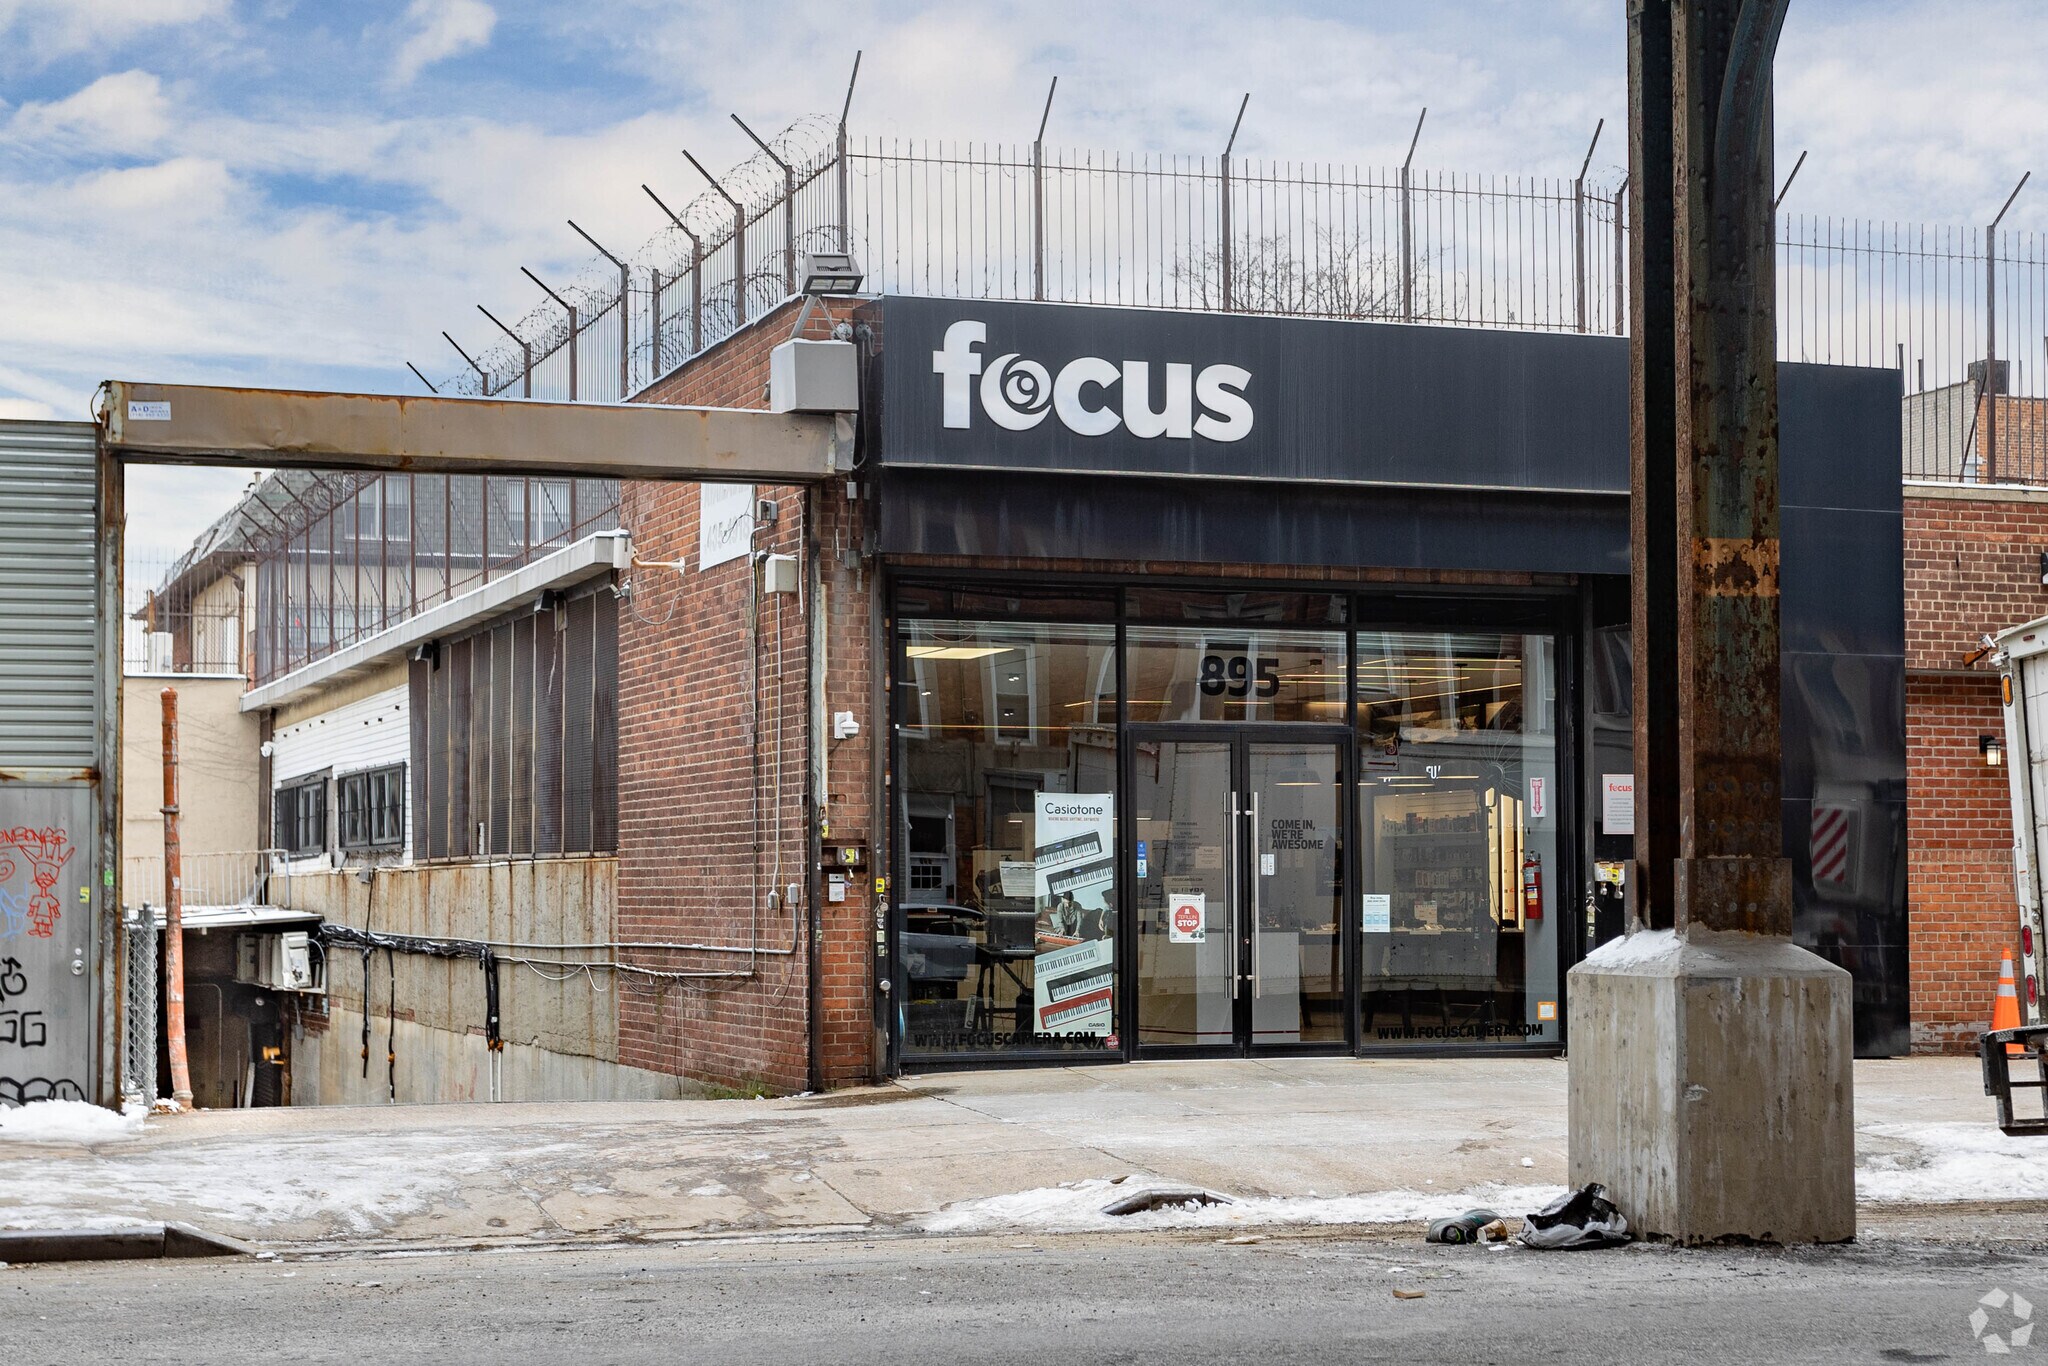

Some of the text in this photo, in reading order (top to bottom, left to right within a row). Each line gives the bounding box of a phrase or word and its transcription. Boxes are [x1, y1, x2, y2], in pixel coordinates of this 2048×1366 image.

[933, 320, 1254, 443] focus
[1763, 563, 1771, 576] A
[1200, 655, 1280, 697] 895
[1045, 802, 1103, 814] Casiotone
[1271, 819, 1316, 831] COME IN,
[1271, 829, 1304, 840] WE'RE
[1271, 839, 1324, 850] AWESOME
[1177, 919, 1198, 927] STOP
[1377, 1023, 1543, 1040] WWW.FOCUSCAMERA.COM
